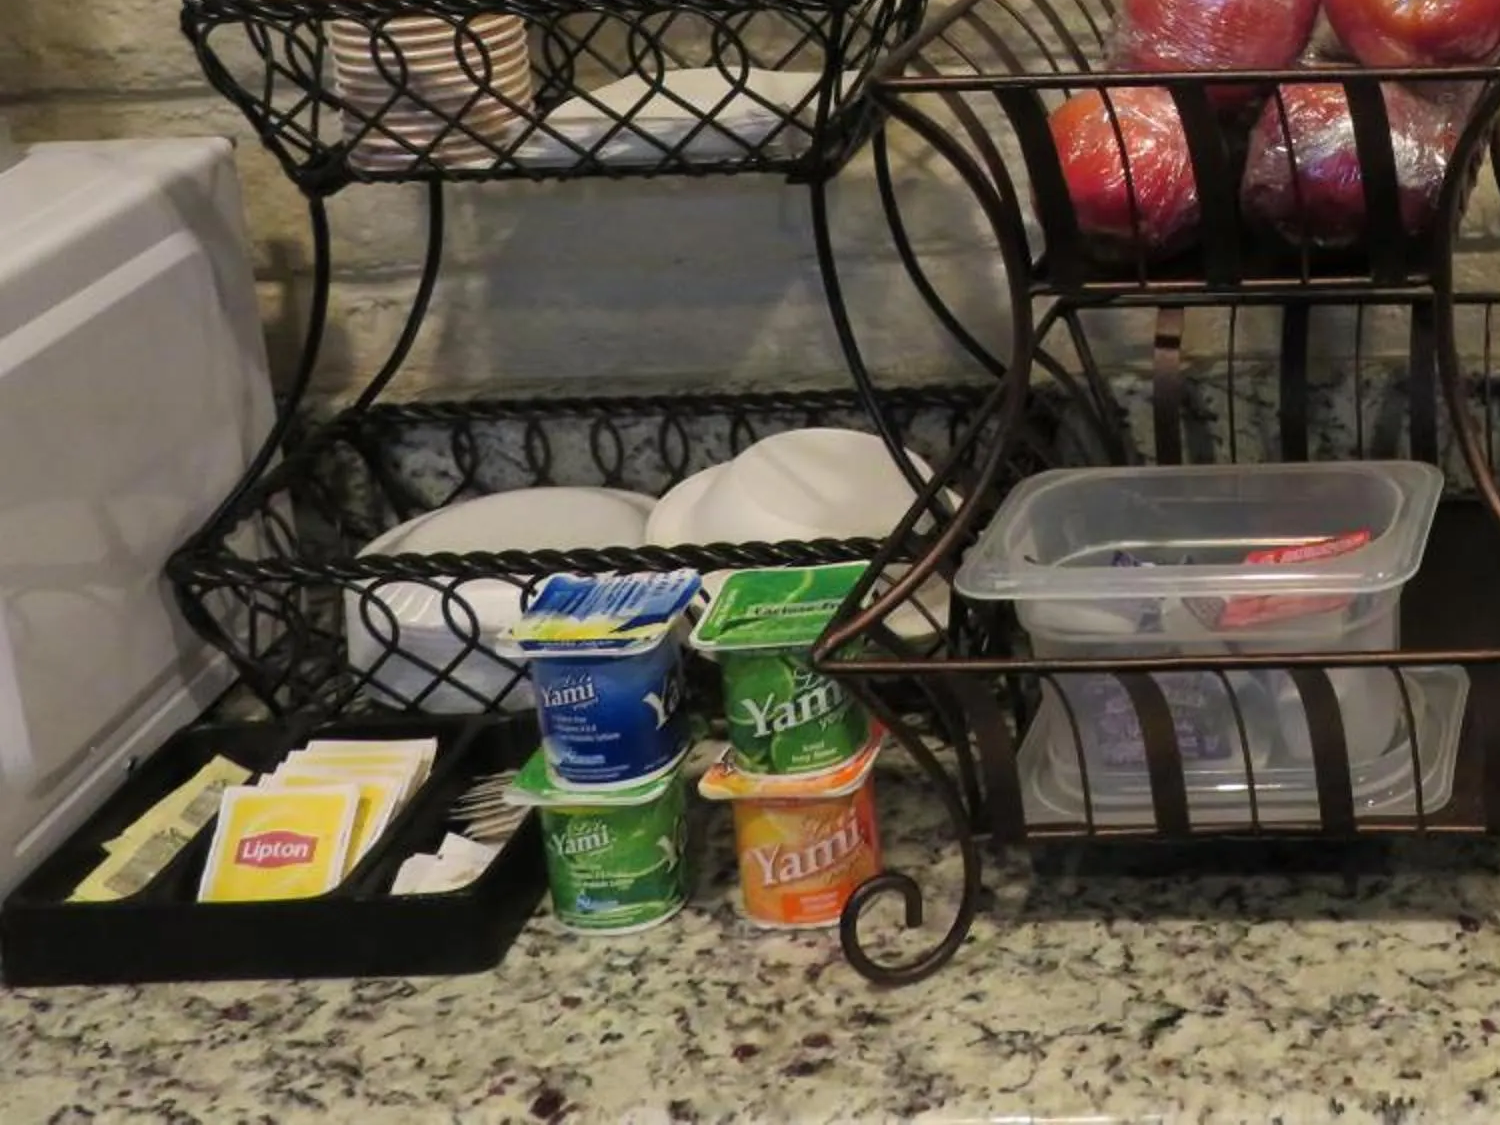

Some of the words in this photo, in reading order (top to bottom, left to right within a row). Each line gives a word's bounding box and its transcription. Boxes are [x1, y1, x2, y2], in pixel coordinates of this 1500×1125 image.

[541, 676, 596, 708] Yami
[741, 678, 847, 738] Yam
[242, 840, 309, 862] Lipton
[551, 821, 611, 856] Yami
[750, 806, 862, 888] Yami
